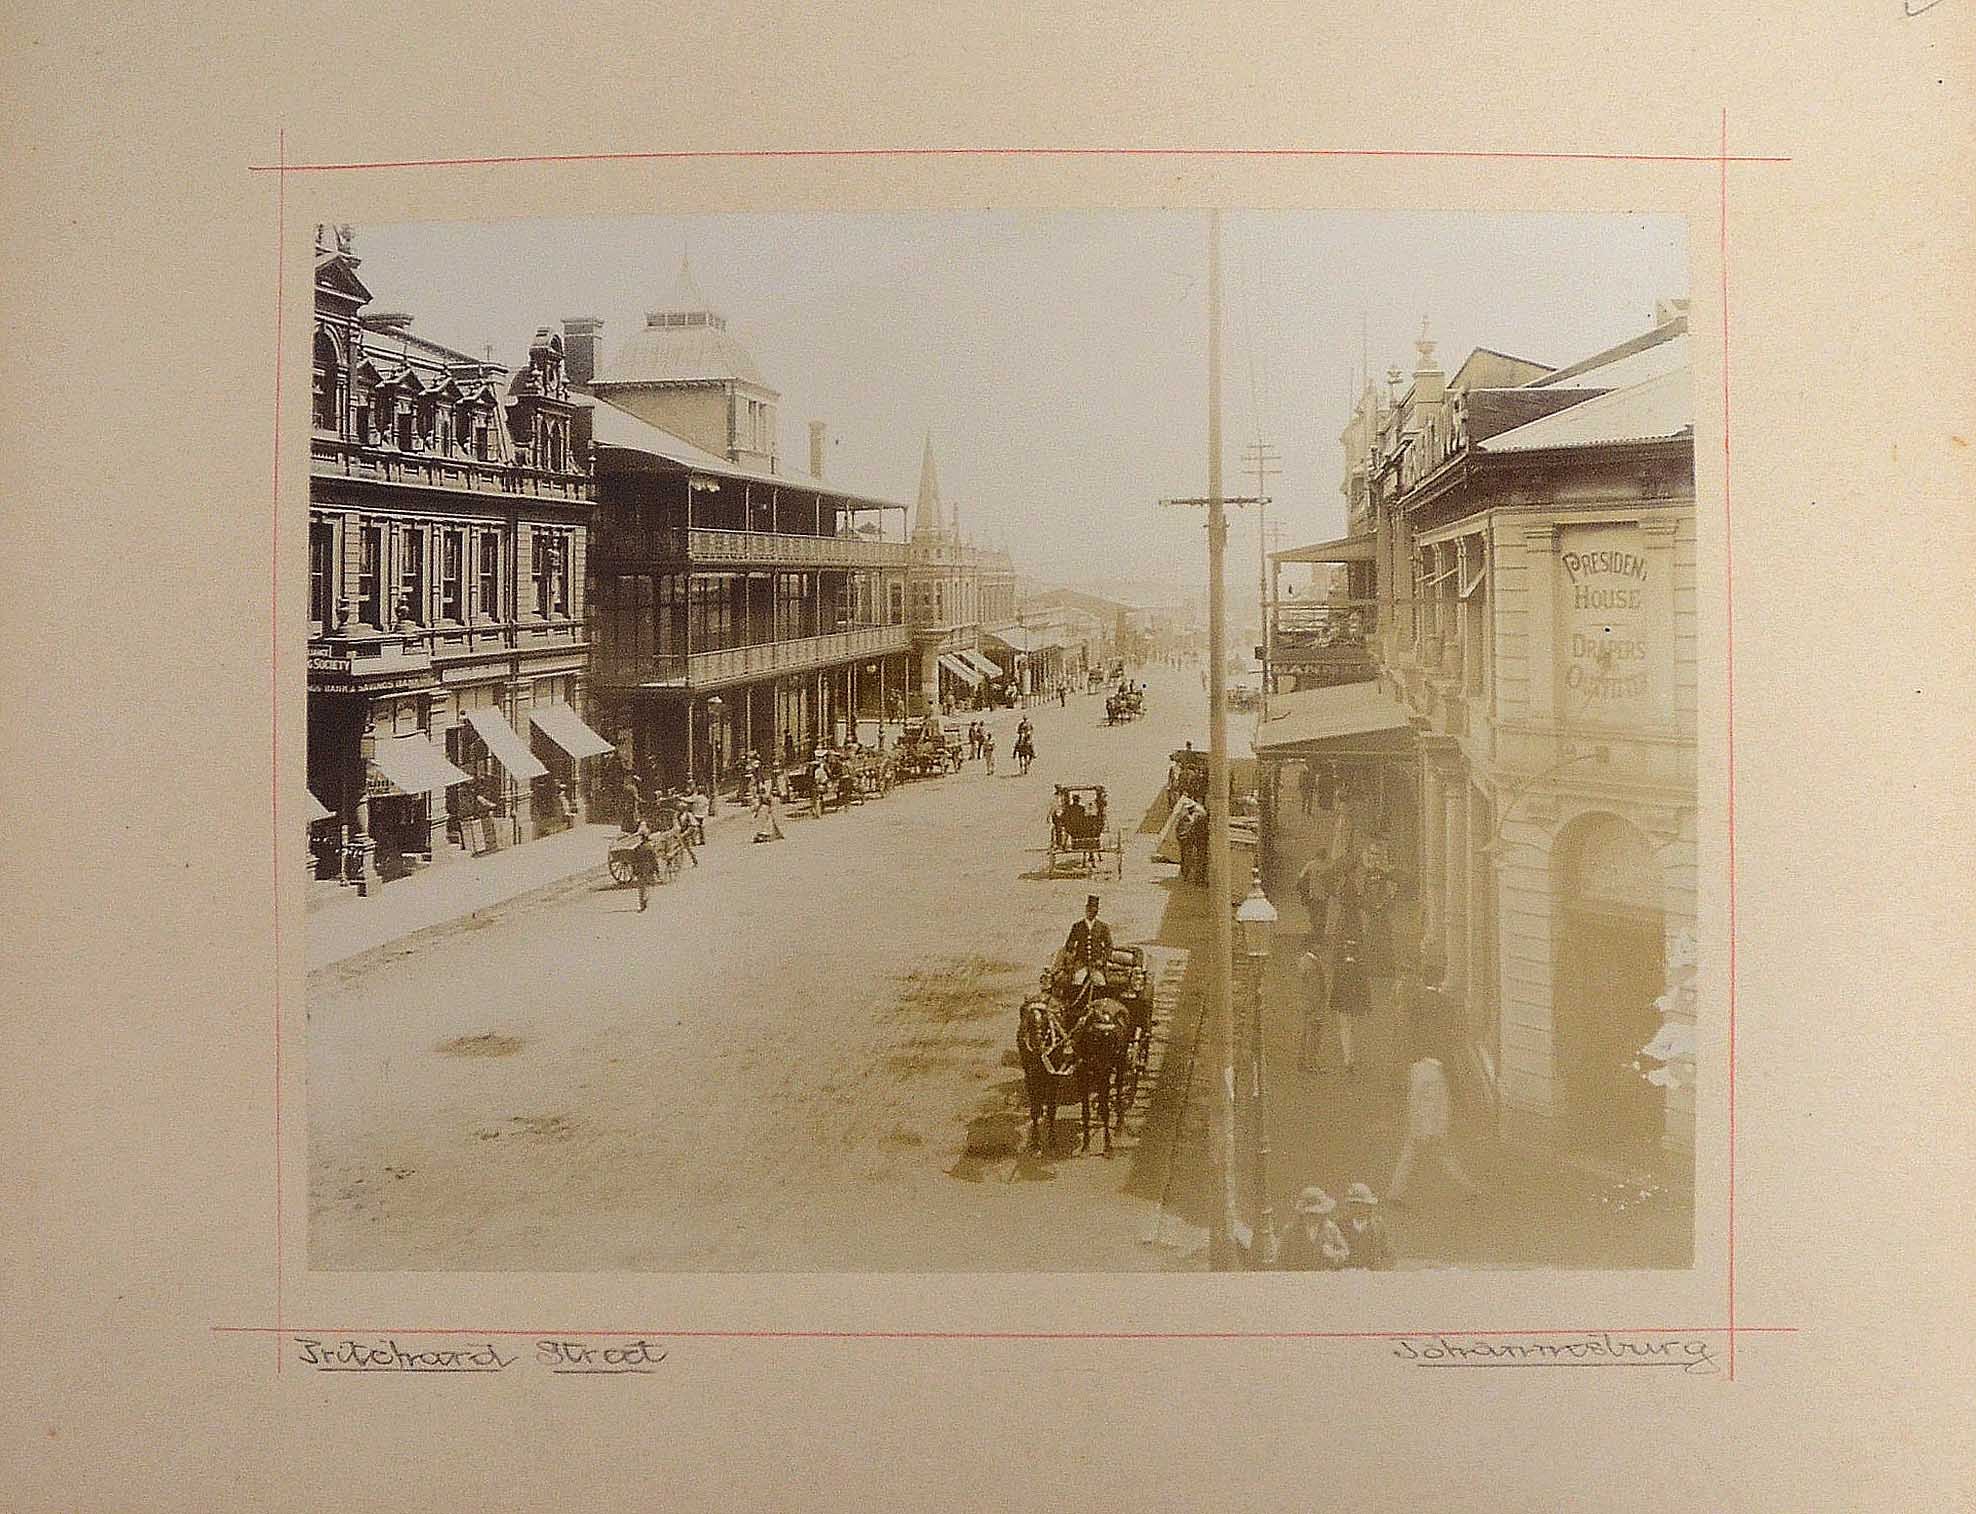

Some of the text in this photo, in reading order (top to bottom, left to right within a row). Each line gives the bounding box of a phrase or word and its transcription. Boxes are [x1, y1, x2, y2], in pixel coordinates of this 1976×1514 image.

[1574, 585, 1641, 609] HOUSE
[313, 657, 350, 671] SOCIETY
[295, 1338, 669, 1367] Pritchard Street
[1391, 1334, 1721, 1374] Johannesburg
